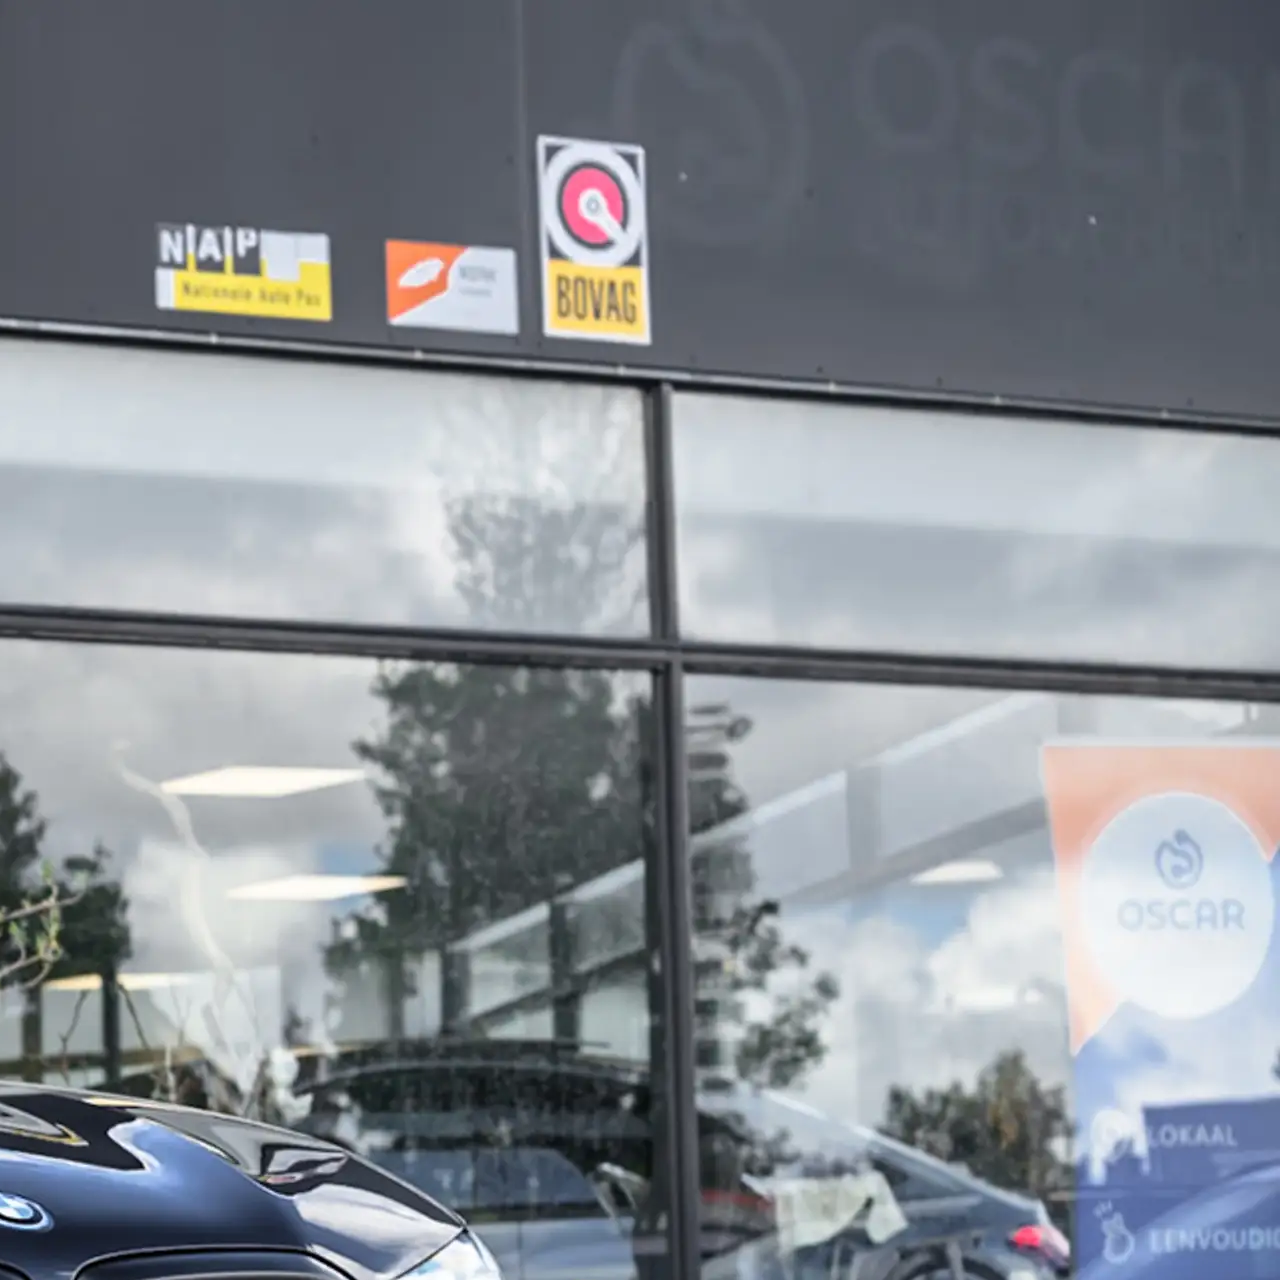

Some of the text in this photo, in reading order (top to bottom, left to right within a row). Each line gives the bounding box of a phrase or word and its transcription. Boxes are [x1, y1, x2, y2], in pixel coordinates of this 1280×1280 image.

[555, 274, 638, 326] BOVAG
[1117, 898, 1246, 932] OSCAR
[1148, 1123, 1238, 1148] LOKAAL
